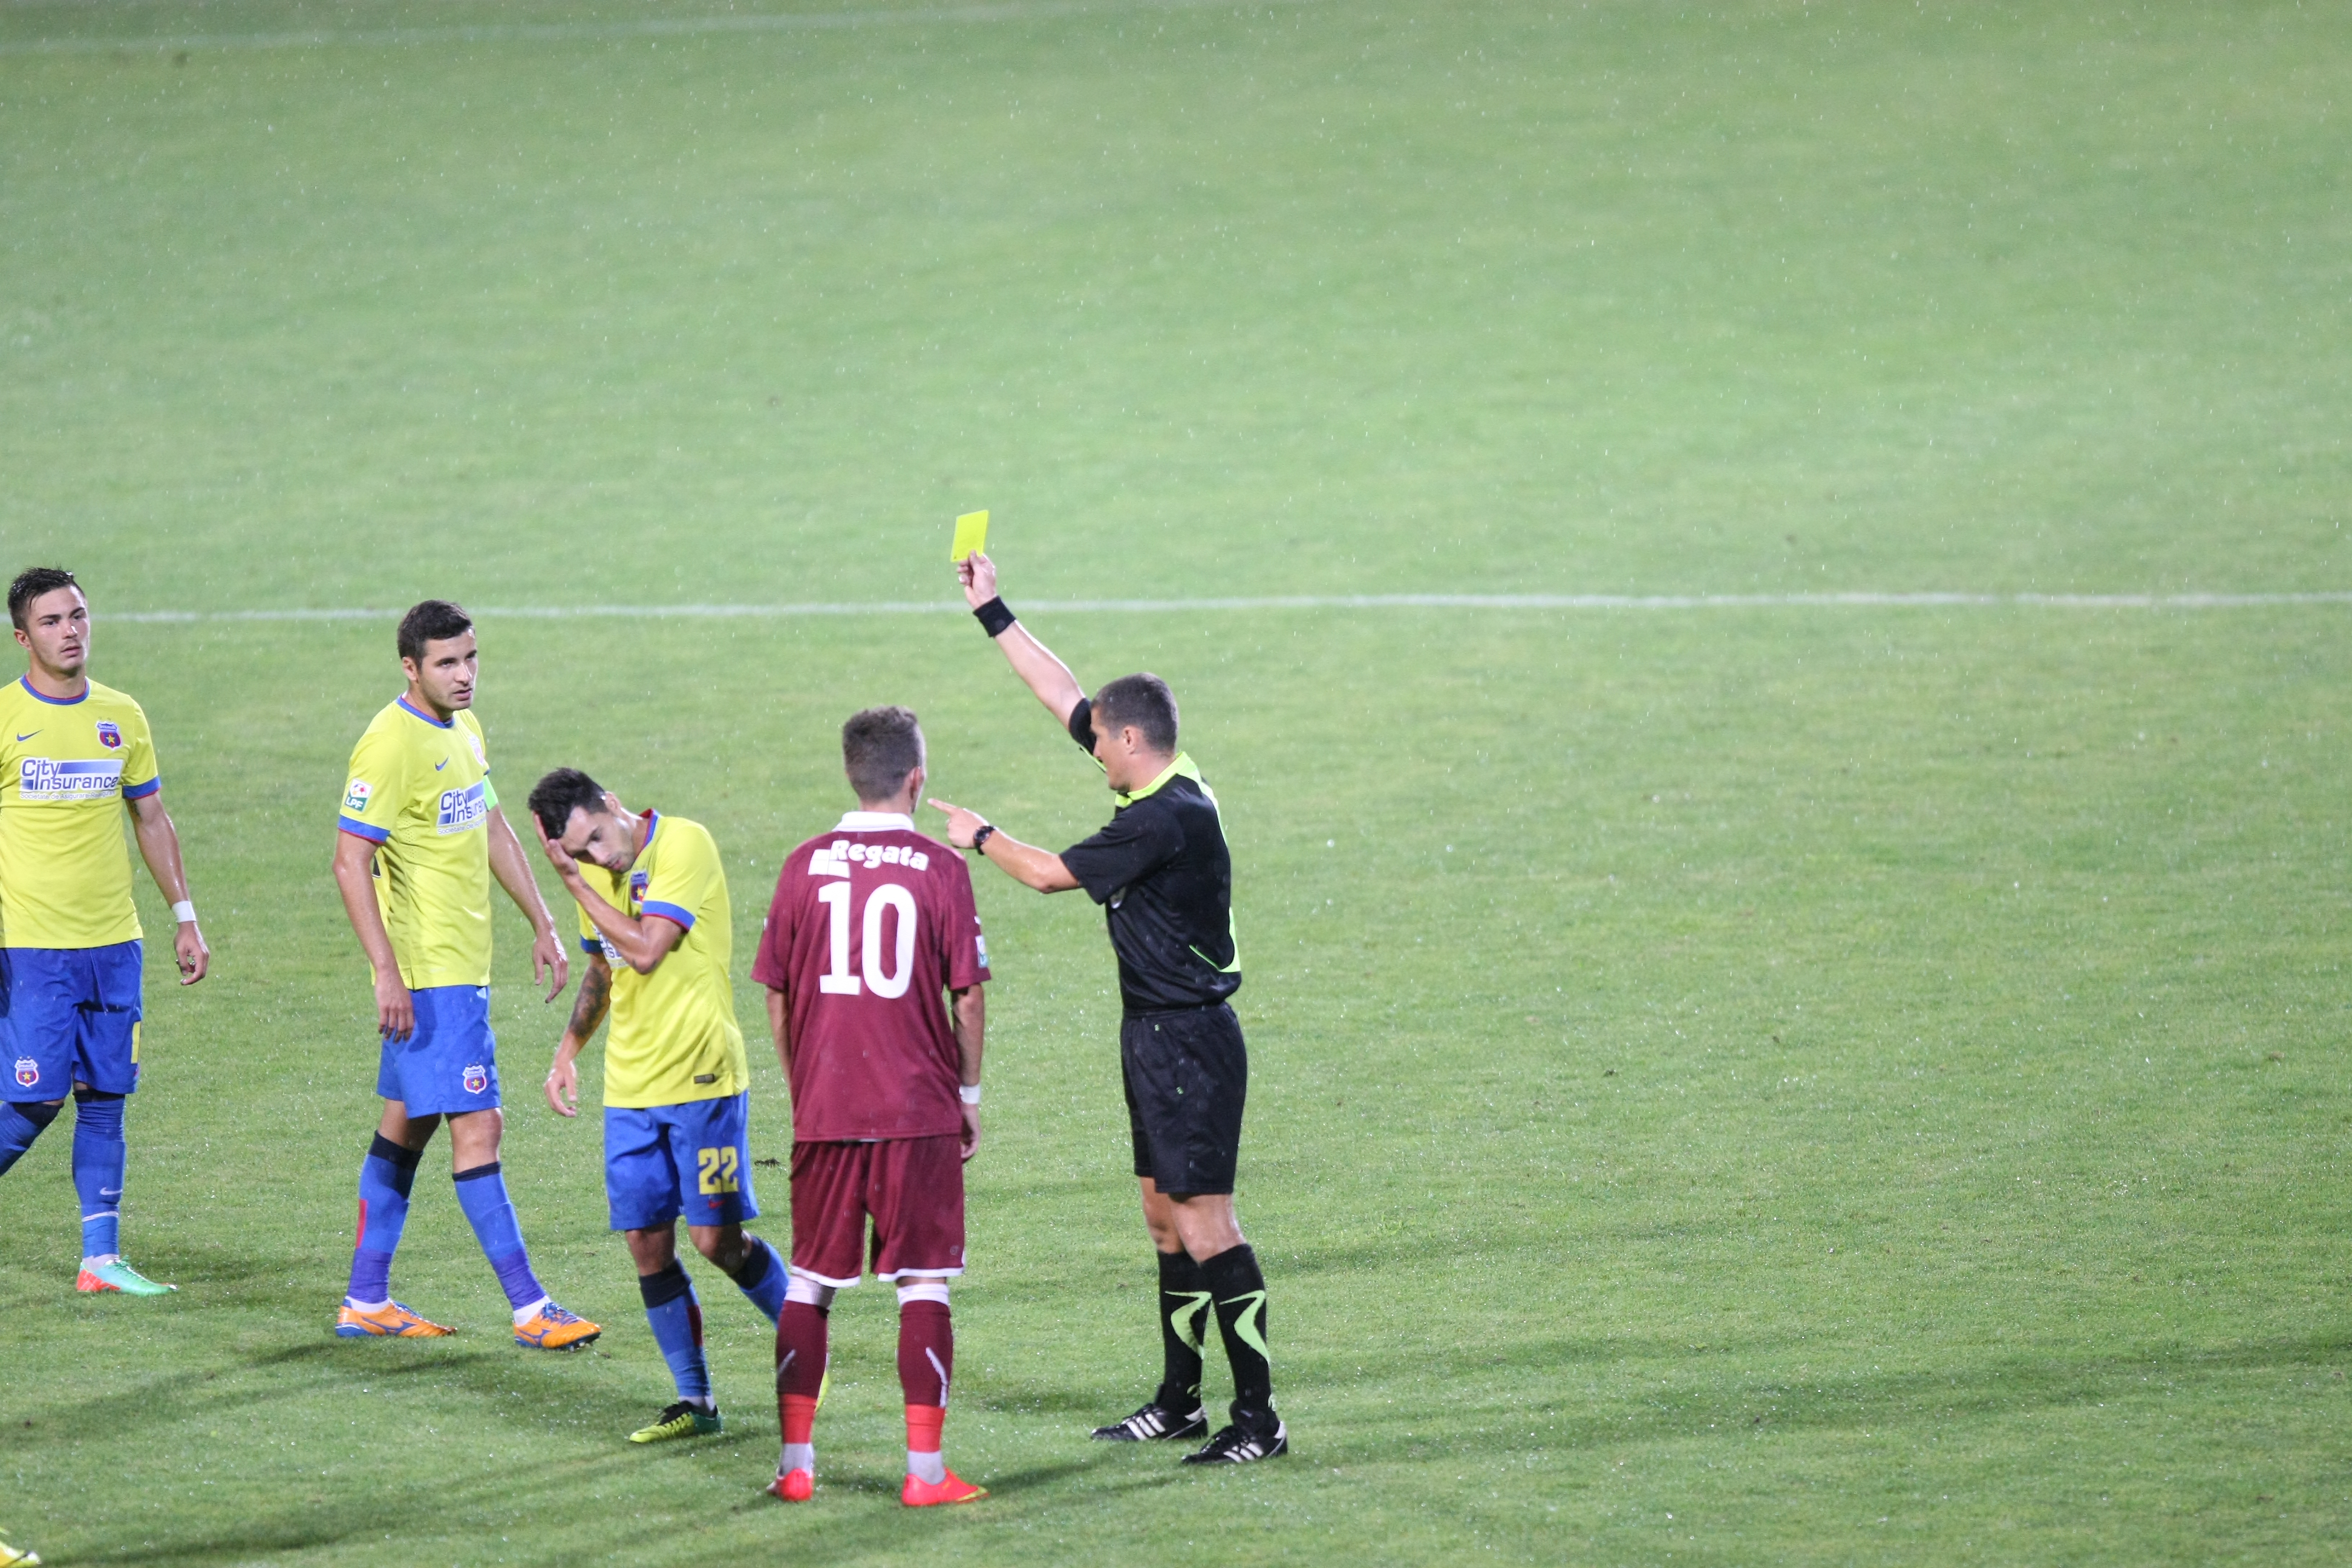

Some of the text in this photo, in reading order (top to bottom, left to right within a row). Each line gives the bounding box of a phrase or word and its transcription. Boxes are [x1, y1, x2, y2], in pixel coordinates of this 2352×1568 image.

[22, 759, 60, 779] City
[346, 796, 364, 808] LPF
[440, 790, 468, 811] City
[830, 840, 929, 871] Regata
[818, 881, 916, 999] 10
[697, 1146, 739, 1195] 22
